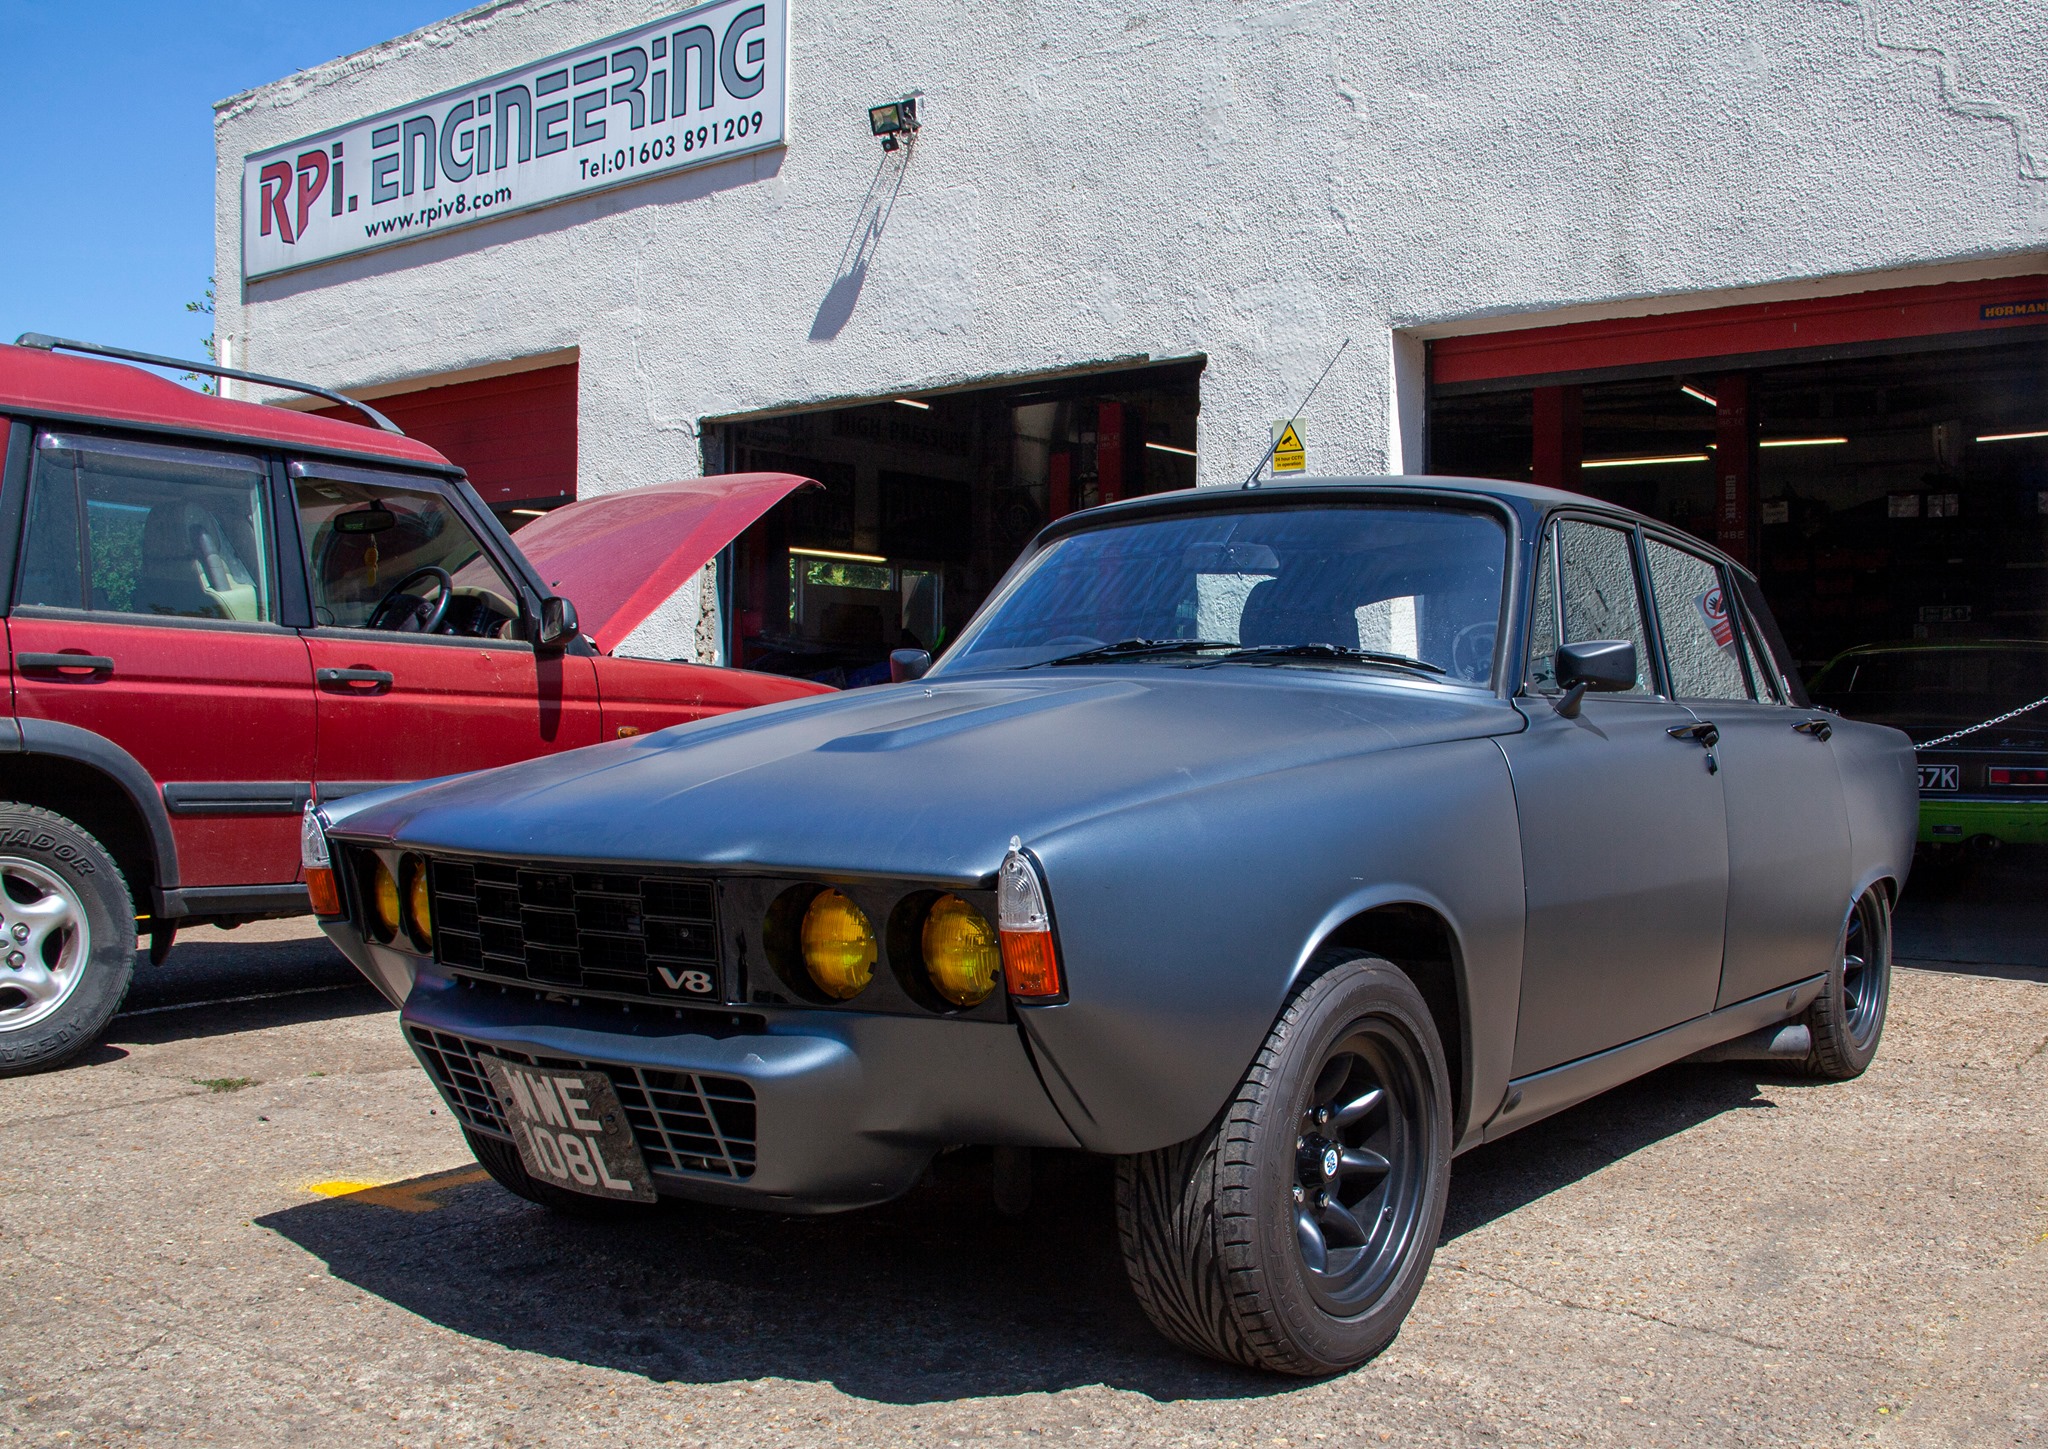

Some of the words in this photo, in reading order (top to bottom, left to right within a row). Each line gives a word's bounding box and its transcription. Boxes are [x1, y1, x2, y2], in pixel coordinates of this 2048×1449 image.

[579, 135, 675, 180] Tel:01603
[684, 111, 763, 152] 891209
[364, 186, 512, 238] www.rpiv8.com
[1985, 302, 2048, 318] HORMAN
[657, 966, 713, 993] V8
[501, 1065, 602, 1132] WWE
[521, 1121, 633, 1191] 108L
